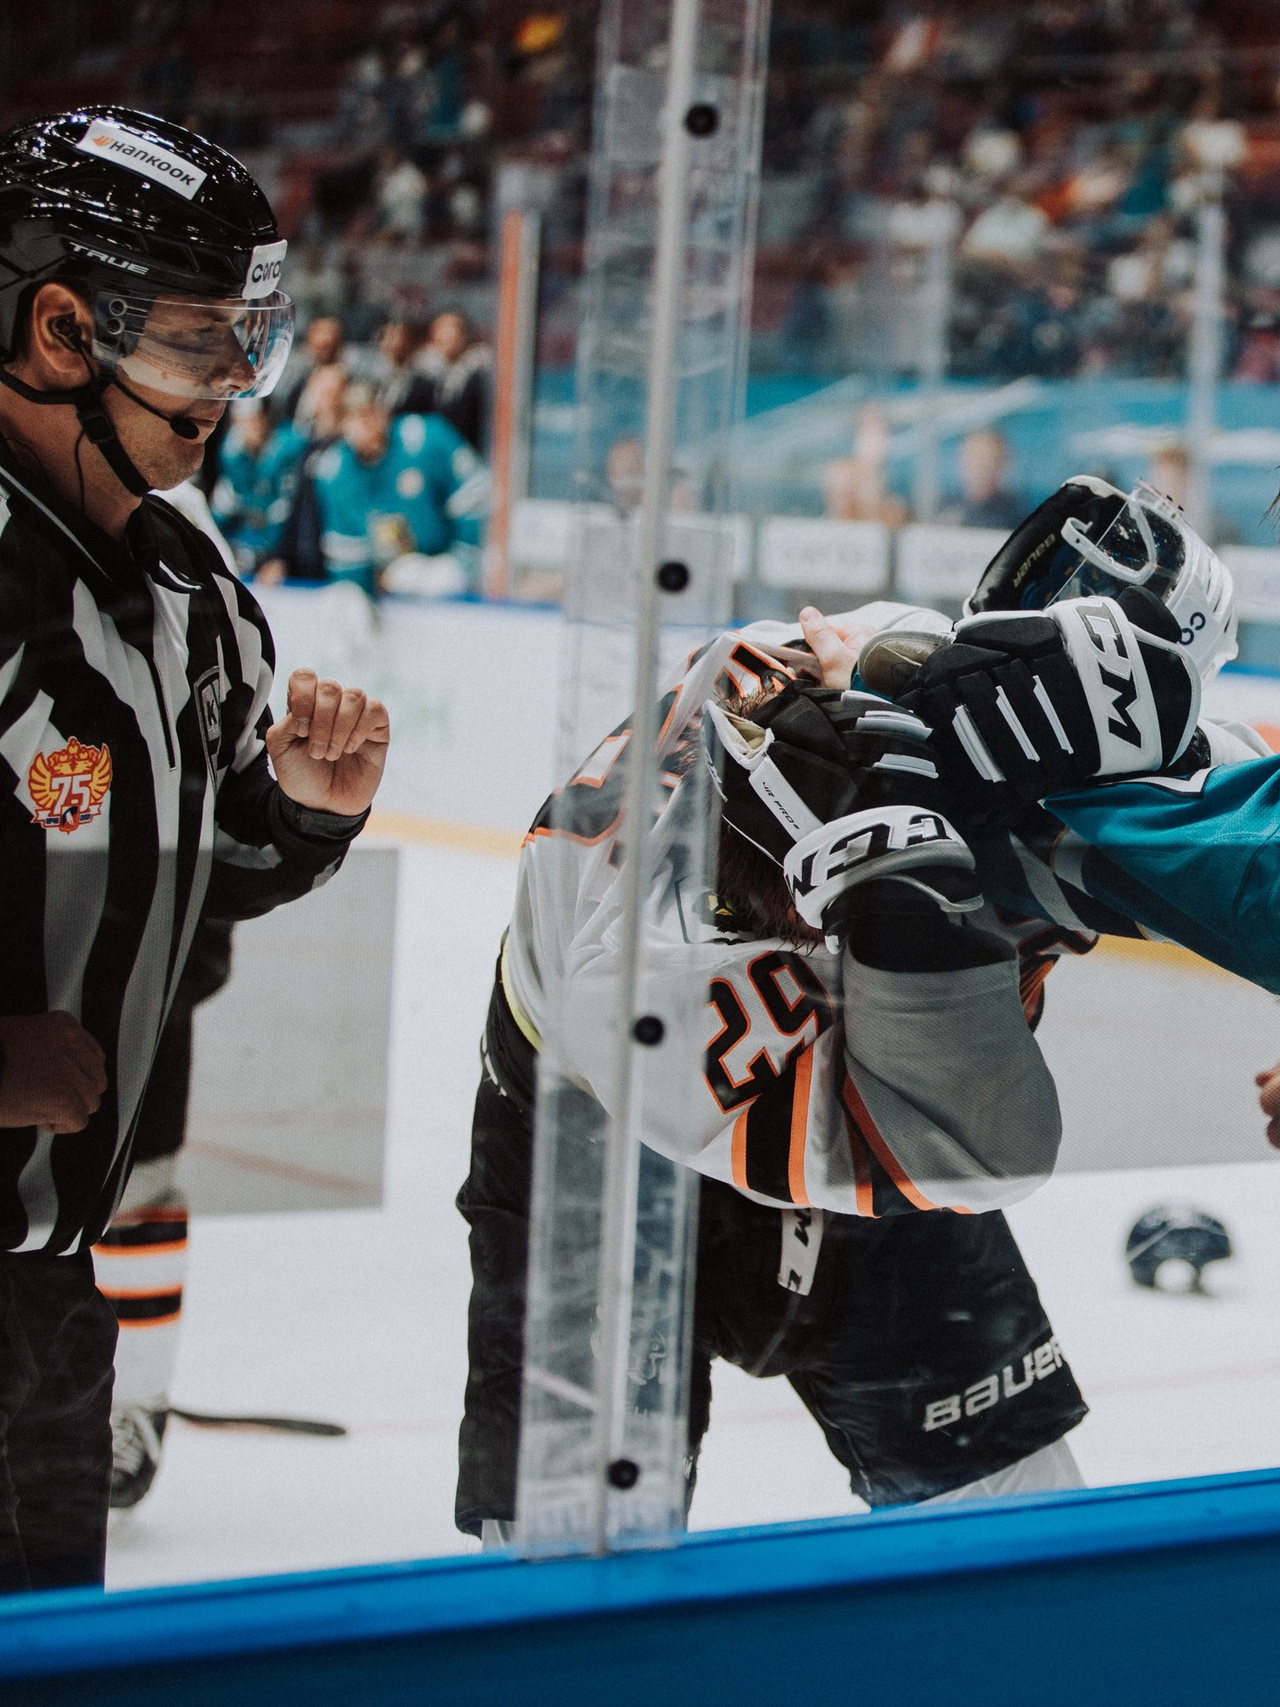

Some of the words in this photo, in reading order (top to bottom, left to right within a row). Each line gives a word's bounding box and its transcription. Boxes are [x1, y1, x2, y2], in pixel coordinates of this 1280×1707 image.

[69, 241, 149, 276] TRUE
[51, 773, 92, 815] 75
[700, 950, 836, 1115] 29
